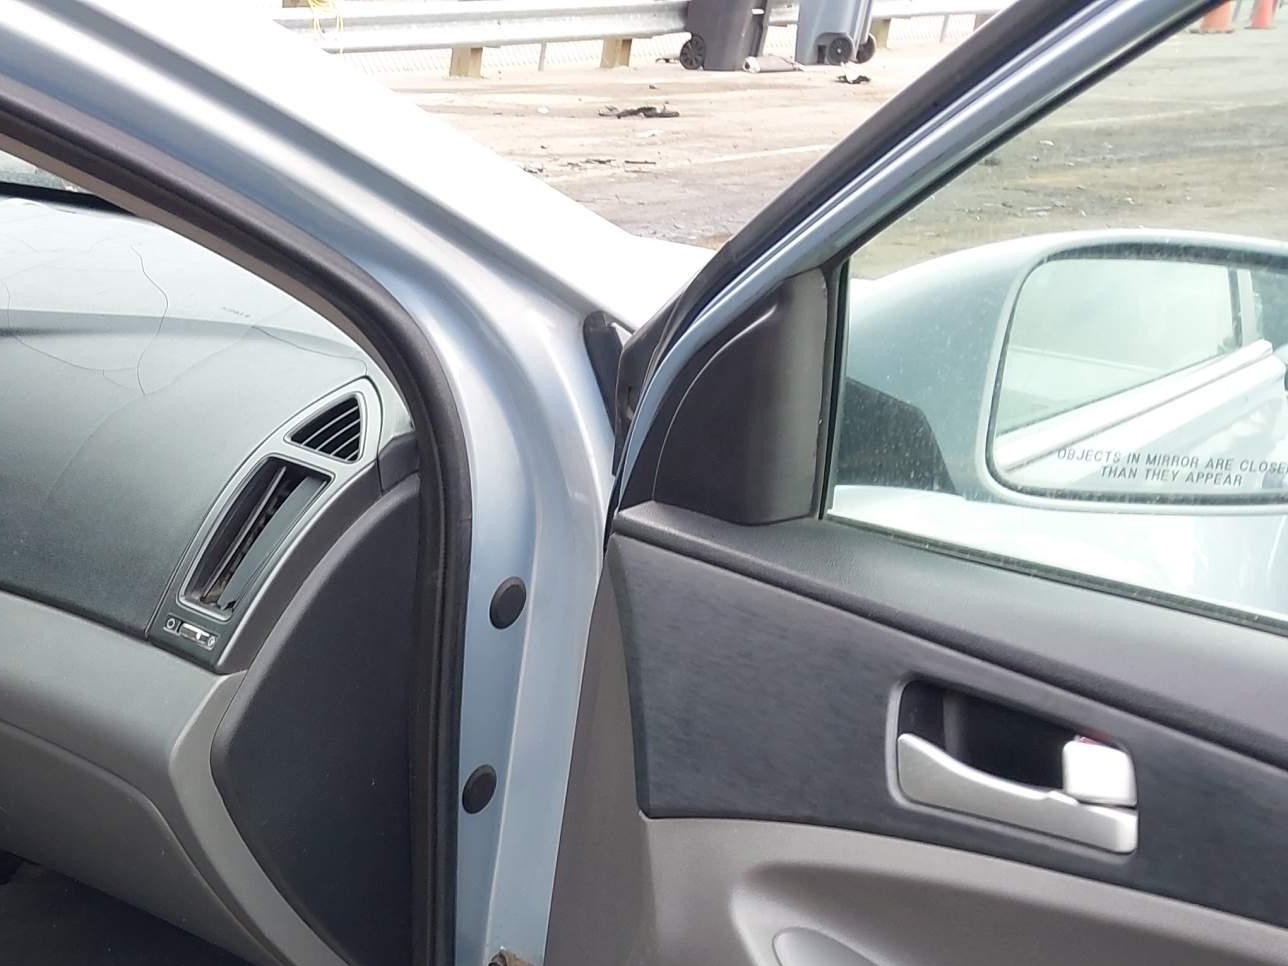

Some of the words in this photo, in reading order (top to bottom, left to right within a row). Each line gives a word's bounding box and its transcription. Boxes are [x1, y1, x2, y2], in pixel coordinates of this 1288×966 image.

[1057, 447, 1122, 464] OBJECTS
[1127, 451, 1141, 465] IN
[1146, 453, 1199, 469] MIRROR
[1205, 457, 1234, 472] ARE
[1240, 459, 1288, 474] CLOSE
[1102, 465, 1138, 479] THAN
[1145, 468, 1179, 482] THEY
[1185, 471, 1243, 487] APPEAR
